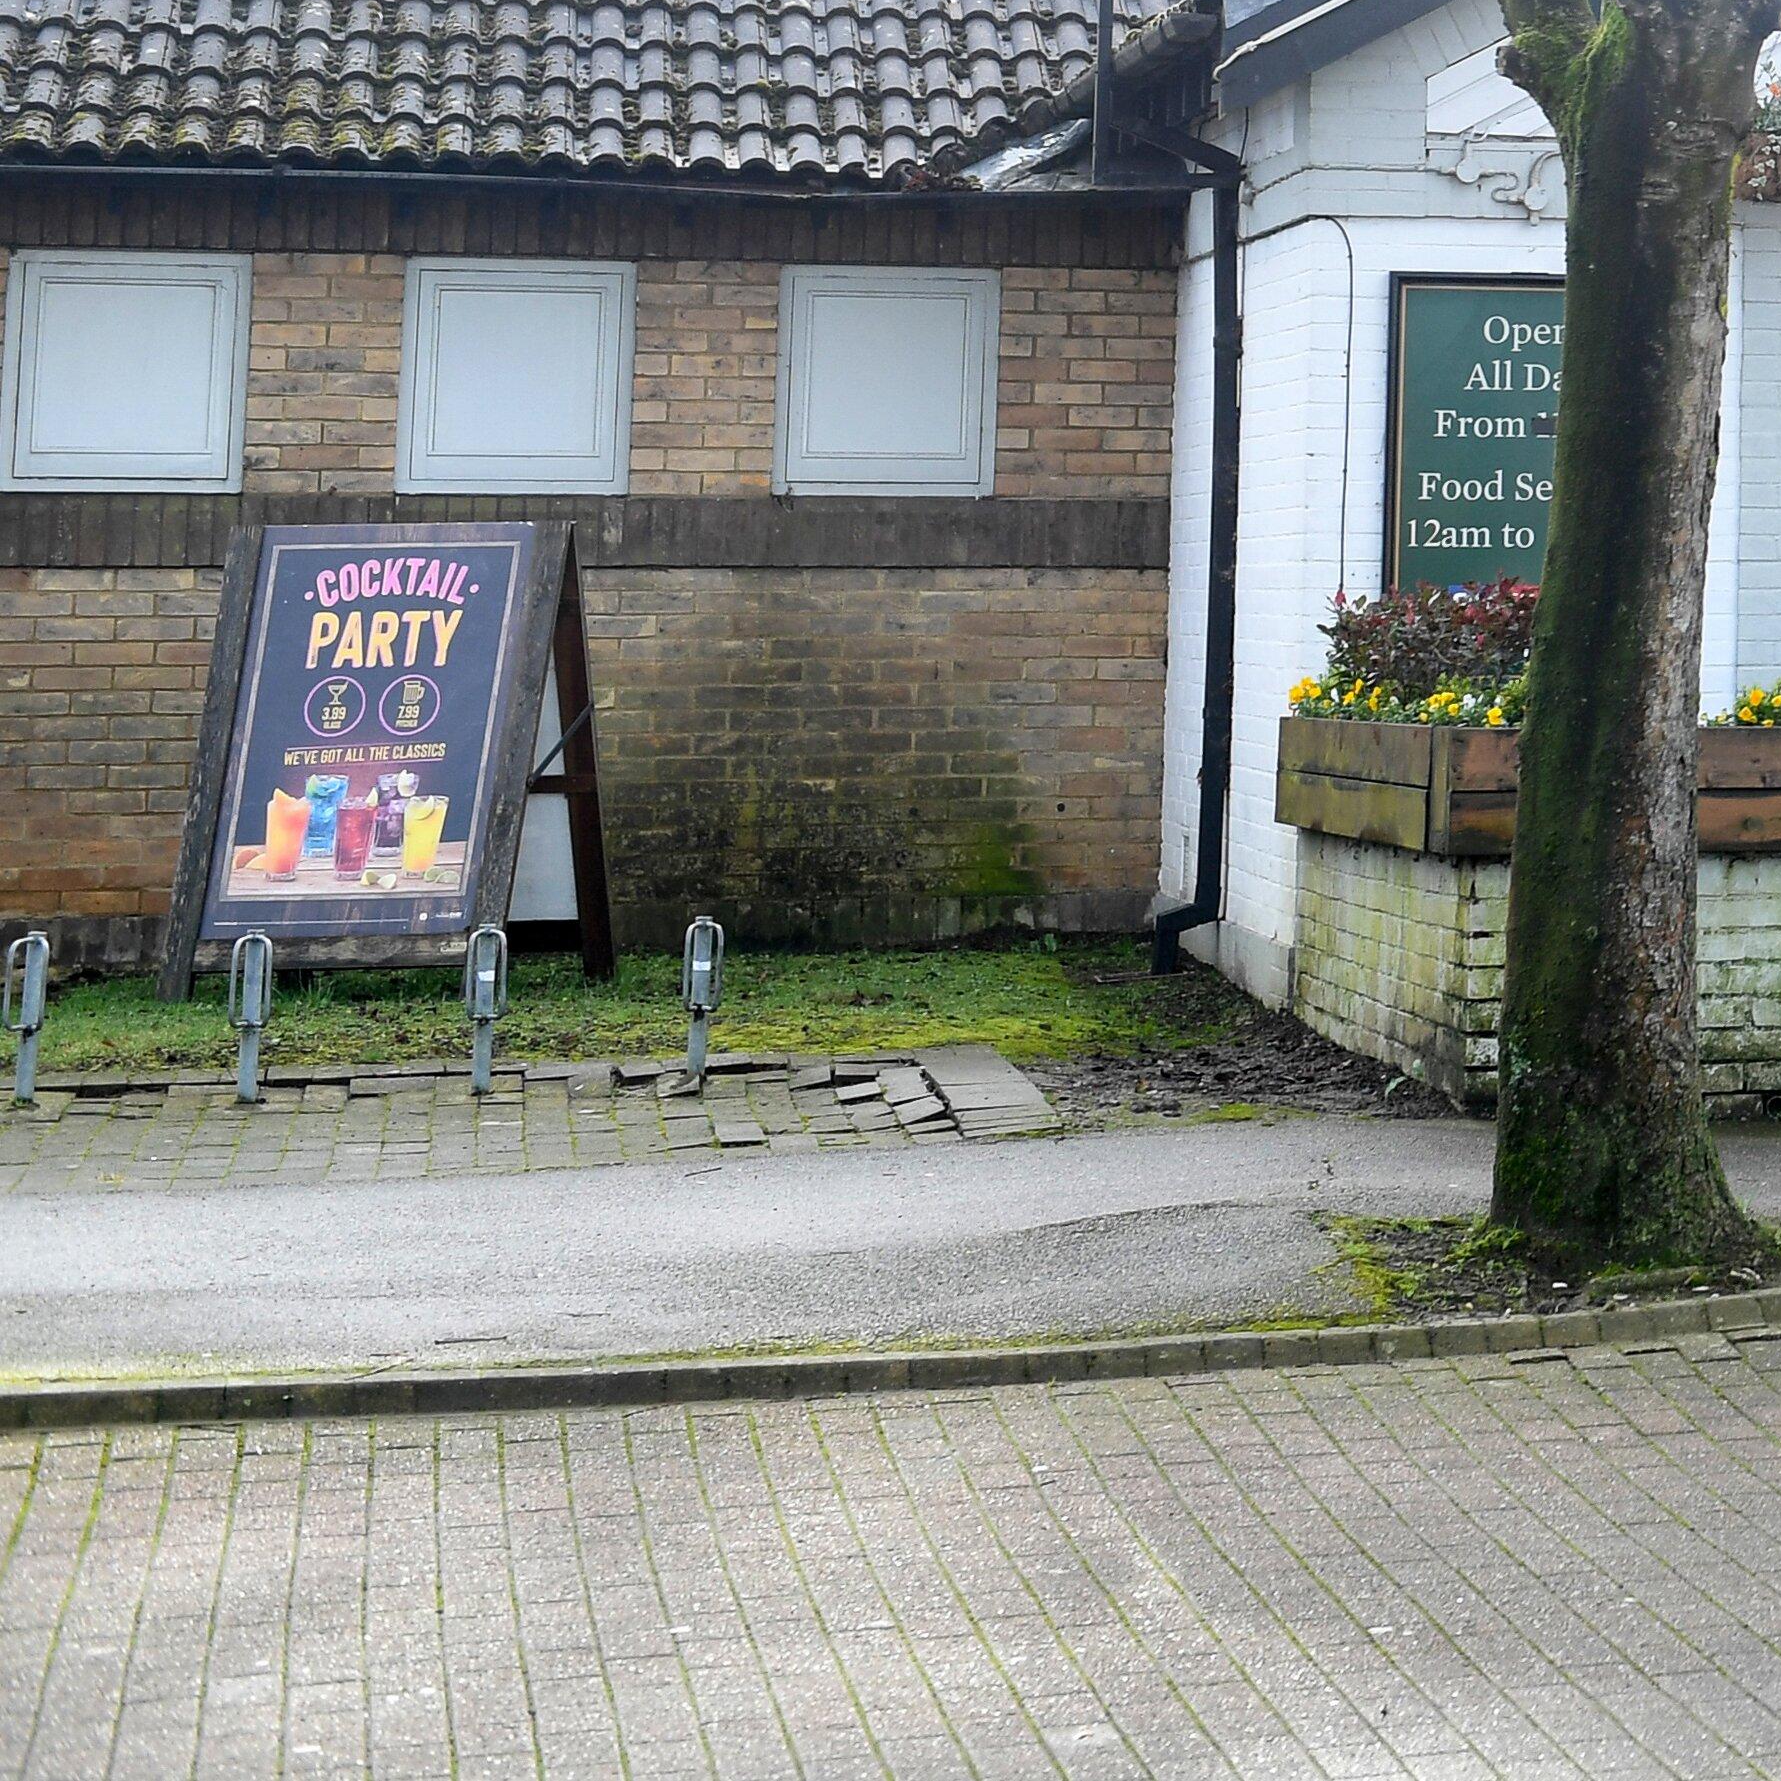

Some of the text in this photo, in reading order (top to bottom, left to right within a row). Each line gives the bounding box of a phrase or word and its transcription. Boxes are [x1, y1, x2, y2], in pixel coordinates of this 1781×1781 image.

[1464, 359, 1514, 391] All
[1433, 409, 1527, 438] From
[1417, 469, 1505, 501] Food
[1407, 519, 1535, 549] 12am to
[316, 557, 469, 608] COCKTAIL
[304, 609, 464, 670] PARTY
[321, 706, 347, 721] 3.89
[397, 705, 420, 719] 7.99
[284, 742, 447, 766] WE'VE GOT ALL THE CLASSICS
